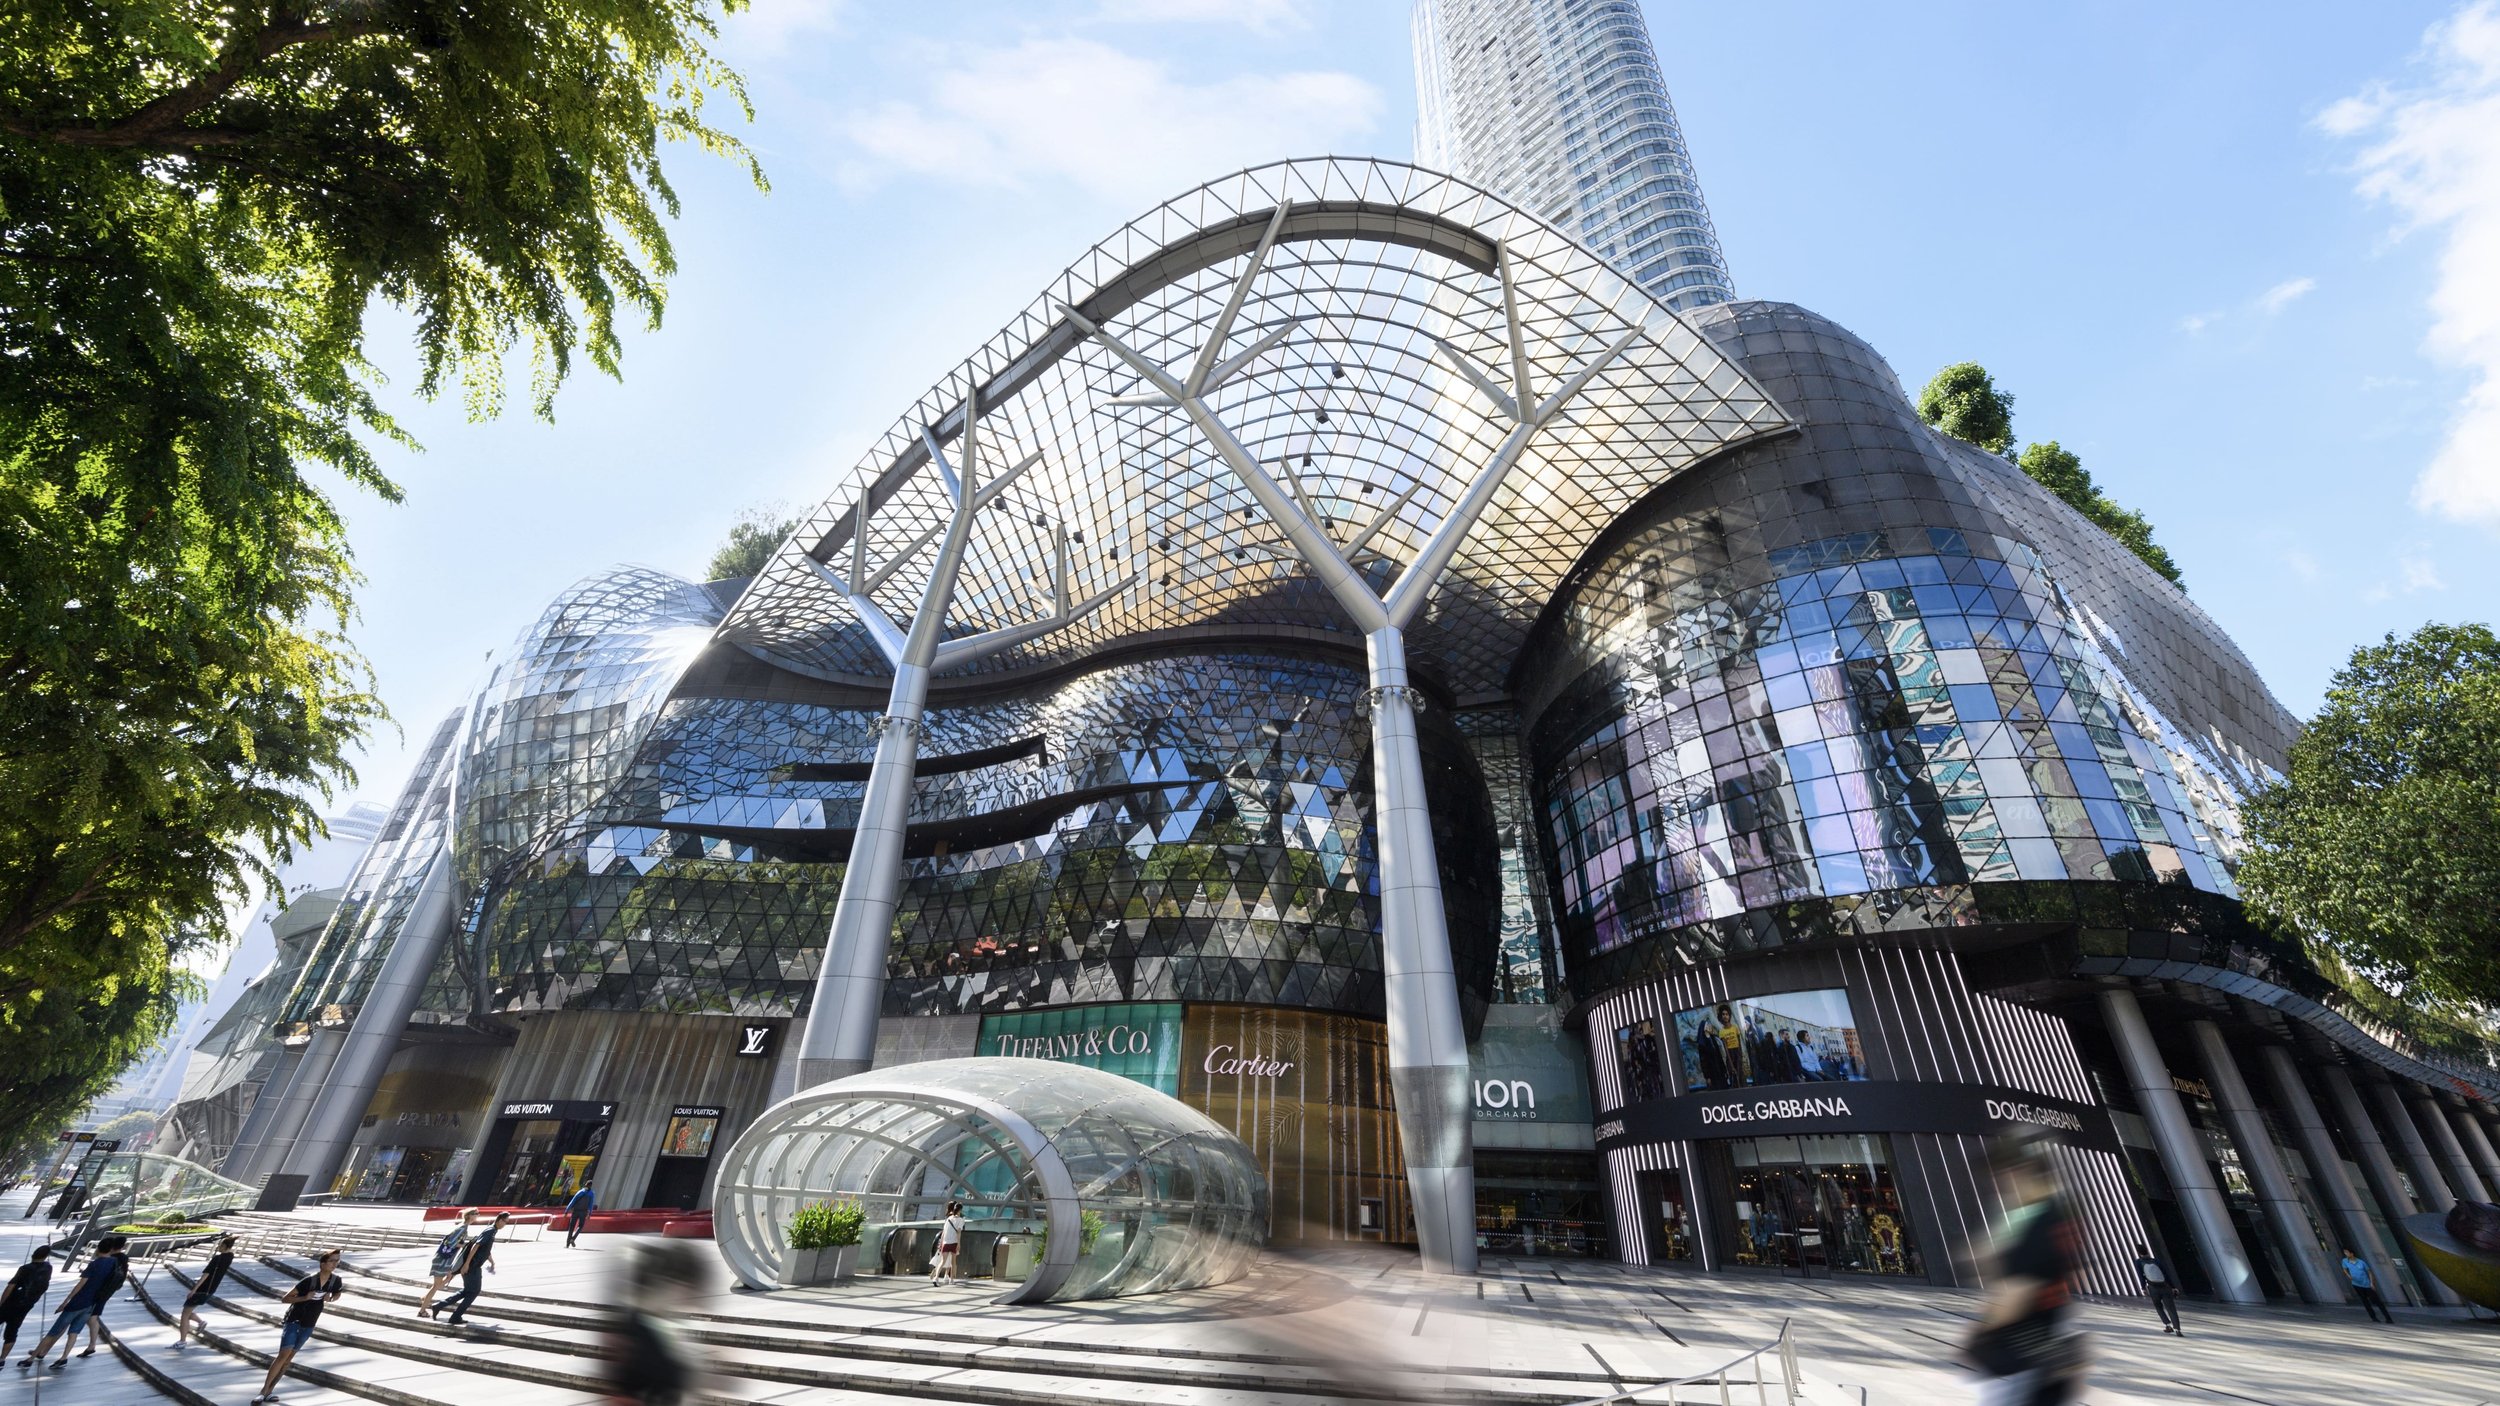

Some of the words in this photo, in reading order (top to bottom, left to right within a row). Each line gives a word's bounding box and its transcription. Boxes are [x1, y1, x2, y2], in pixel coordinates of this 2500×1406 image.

[1203, 1044, 1295, 1078] Cartier
[504, 1104, 522, 1115] LOUIS
[521, 1103, 553, 1115] VUITTON
[674, 1107, 692, 1115] LOUIS
[693, 1108, 720, 1116] VUITTON
[1476, 1110, 1537, 1119] ORCHARD
